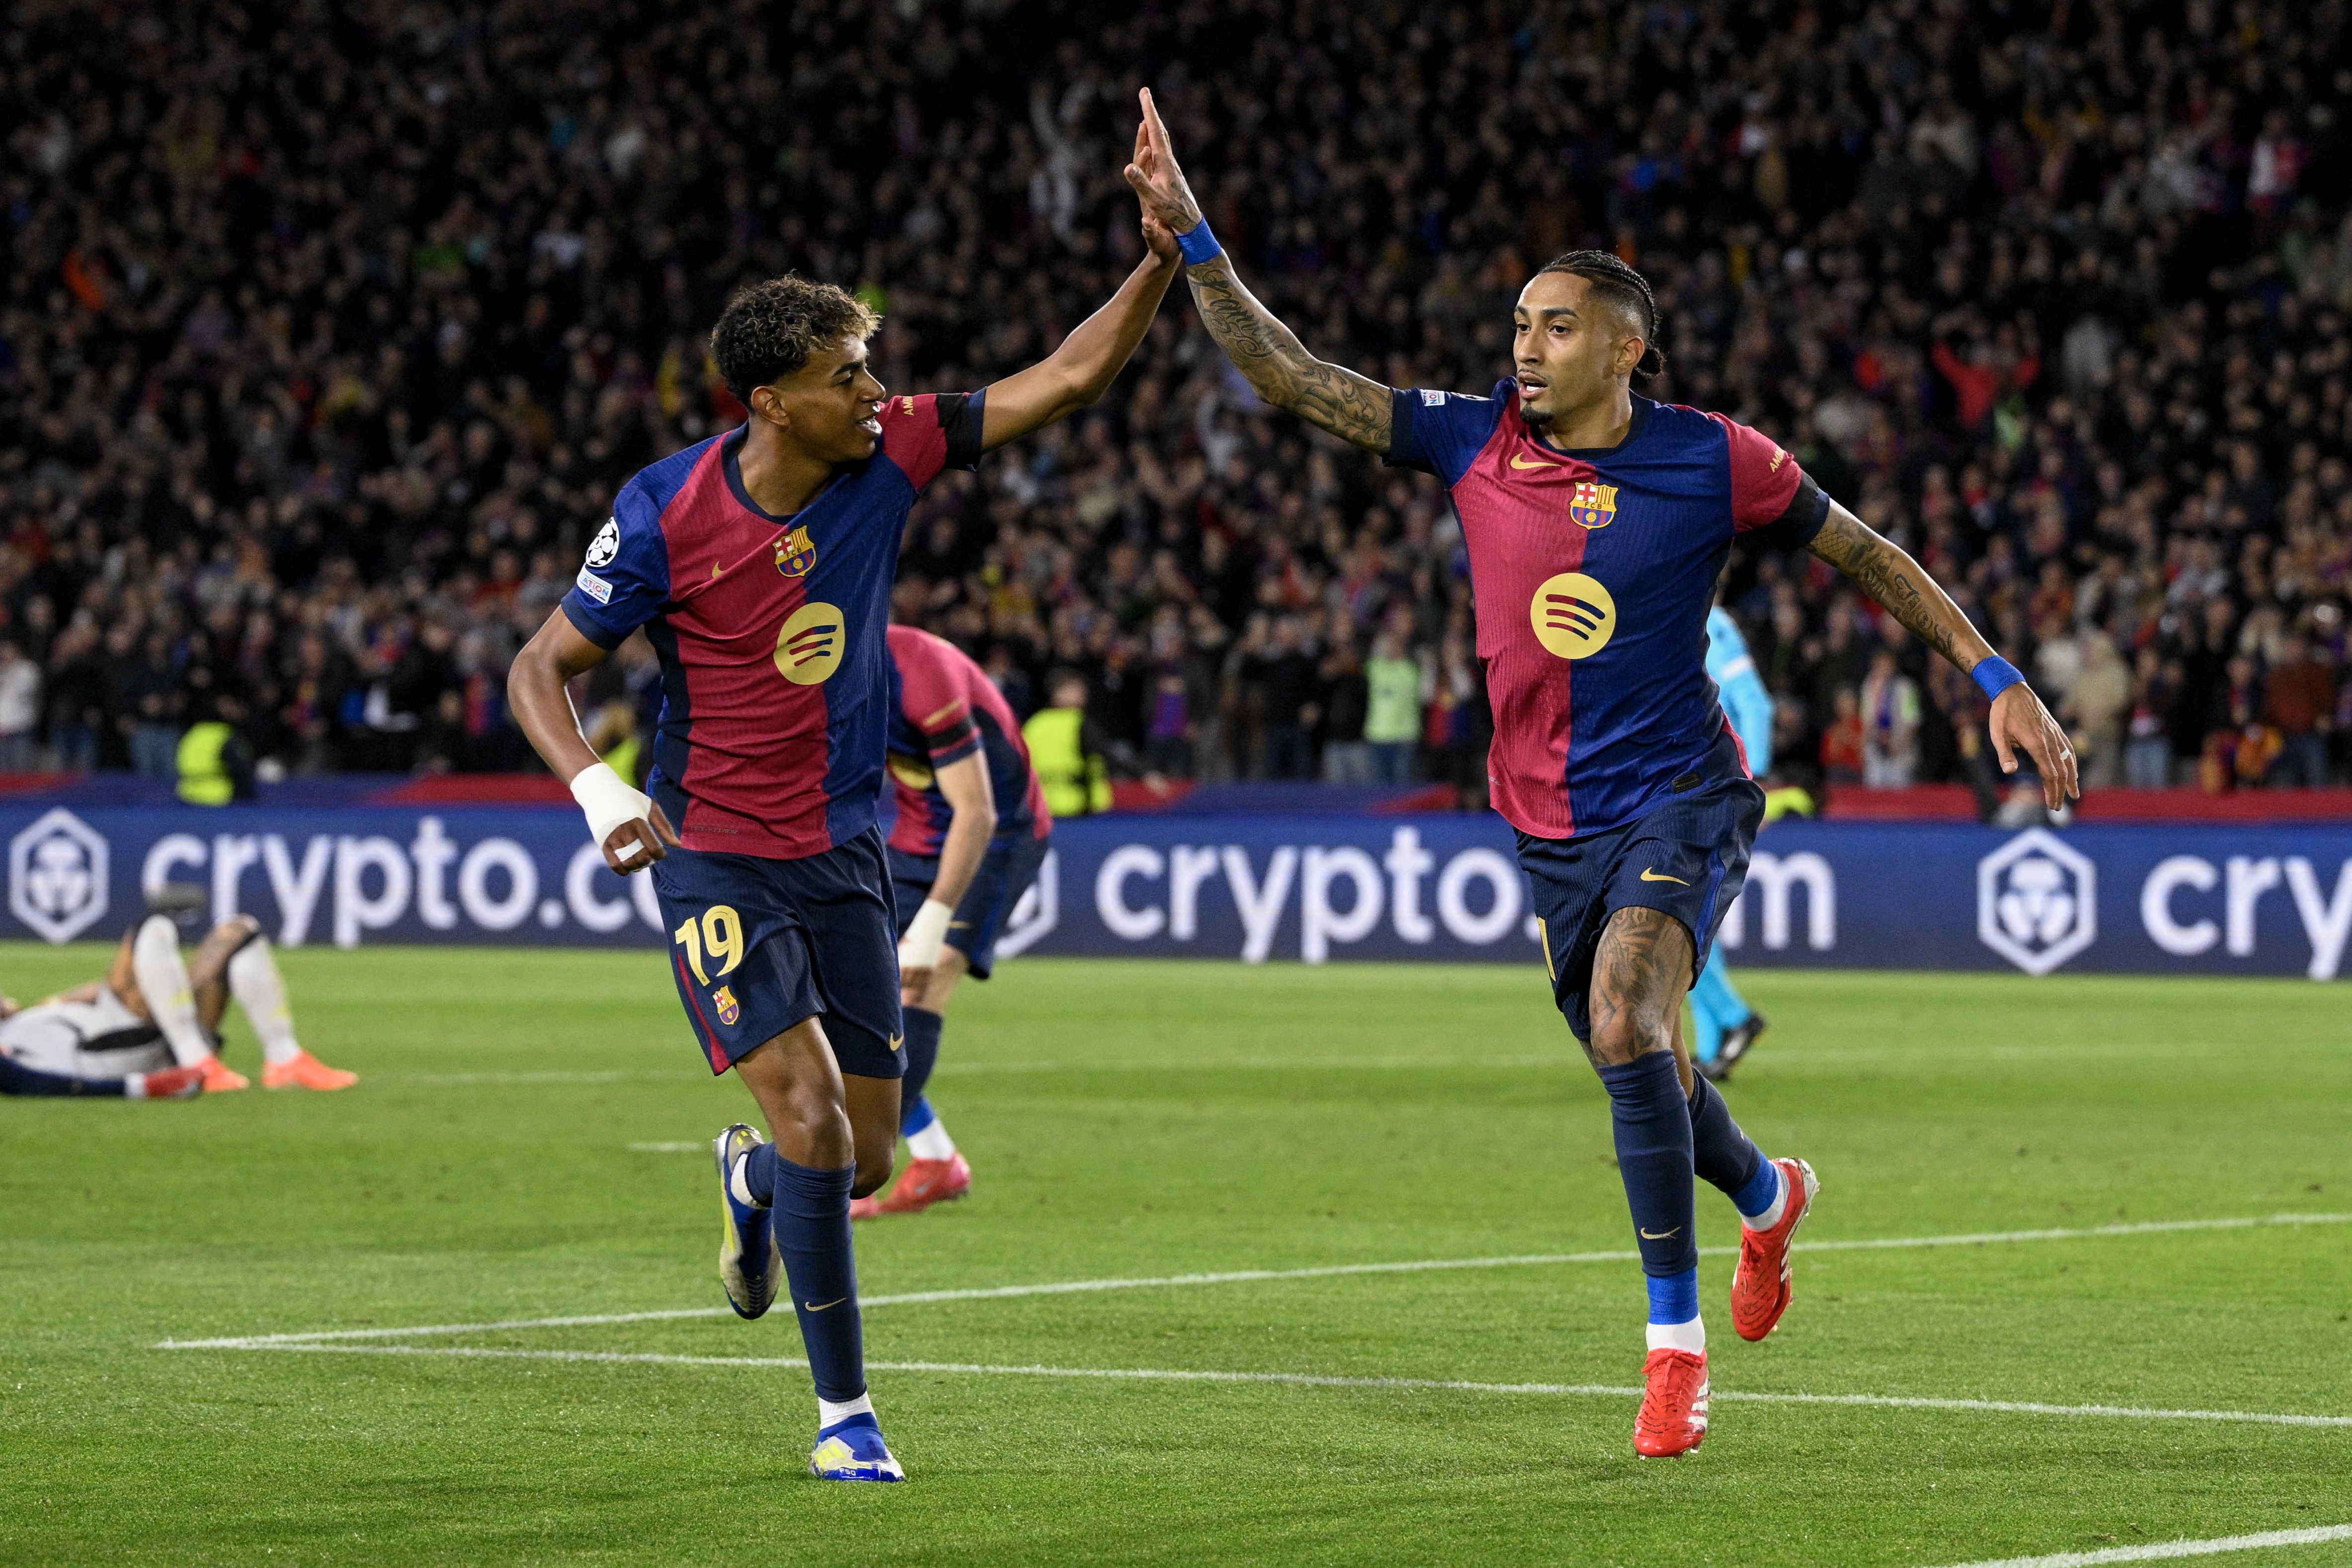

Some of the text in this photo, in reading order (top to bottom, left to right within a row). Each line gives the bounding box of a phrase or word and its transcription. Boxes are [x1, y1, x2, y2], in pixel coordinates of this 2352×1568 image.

[786, 547, 802, 559] FCB
[675, 905, 743, 987] 19
[2140, 855, 2352, 981] cry
